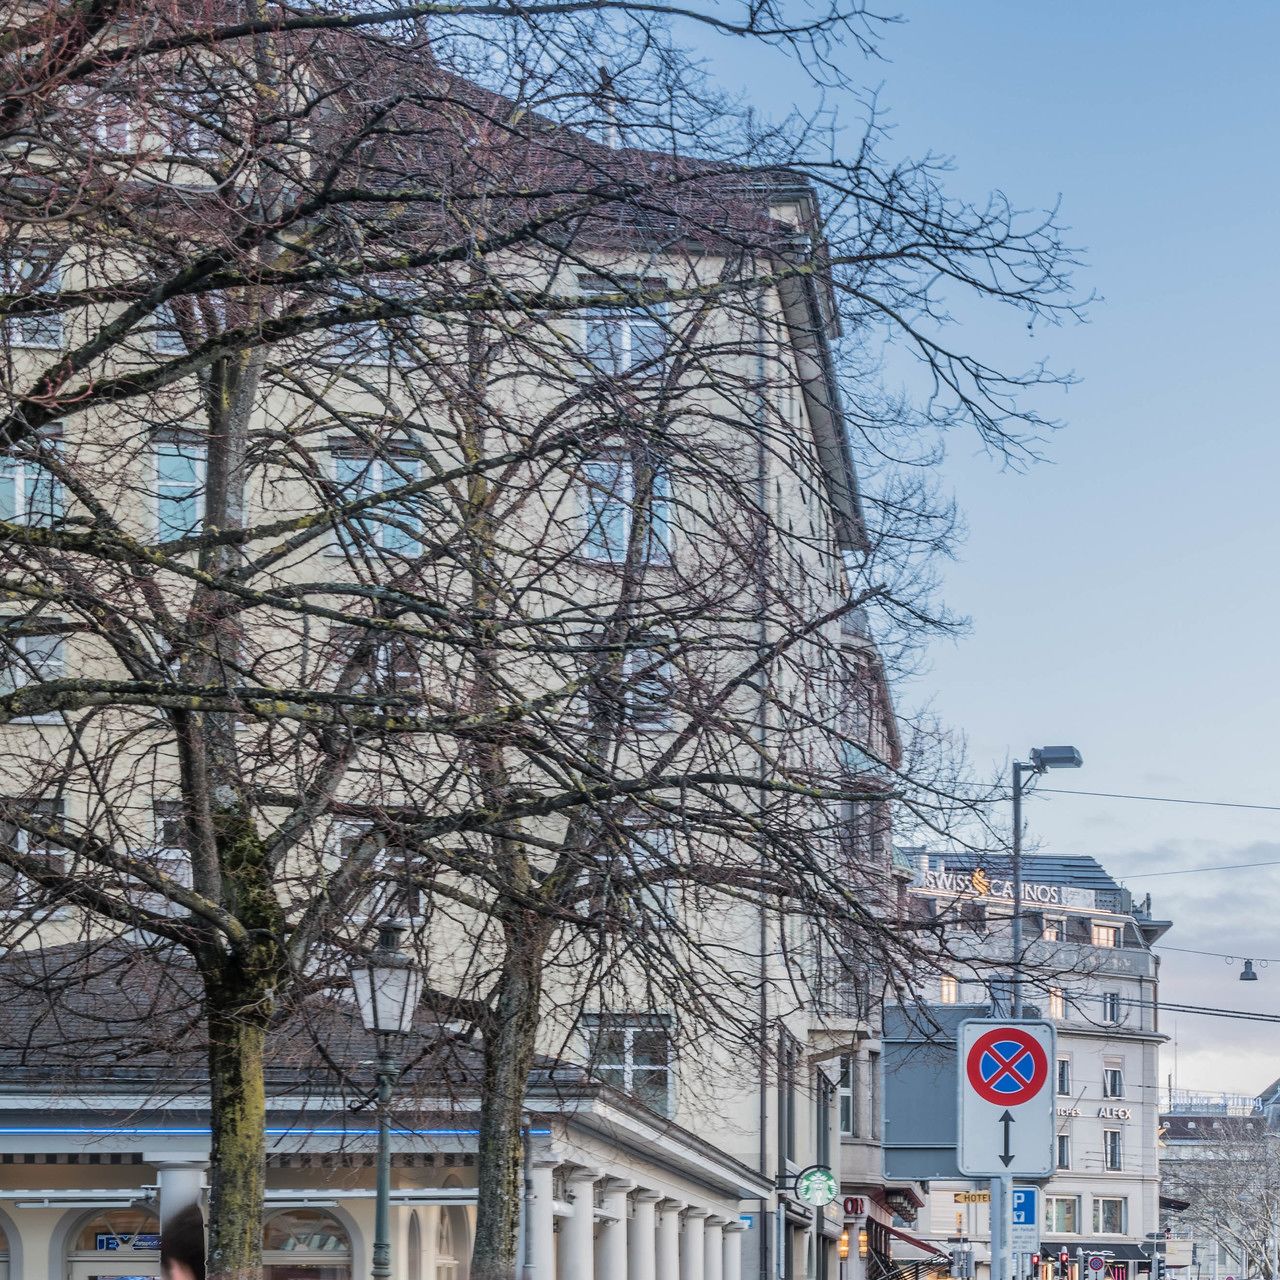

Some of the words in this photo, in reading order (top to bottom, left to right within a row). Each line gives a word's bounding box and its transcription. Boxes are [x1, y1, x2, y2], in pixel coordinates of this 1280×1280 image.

[925, 871, 979, 893] SWISS
[990, 880, 1059, 902] CAINOS
[1013, 1192, 1025, 1208] P
